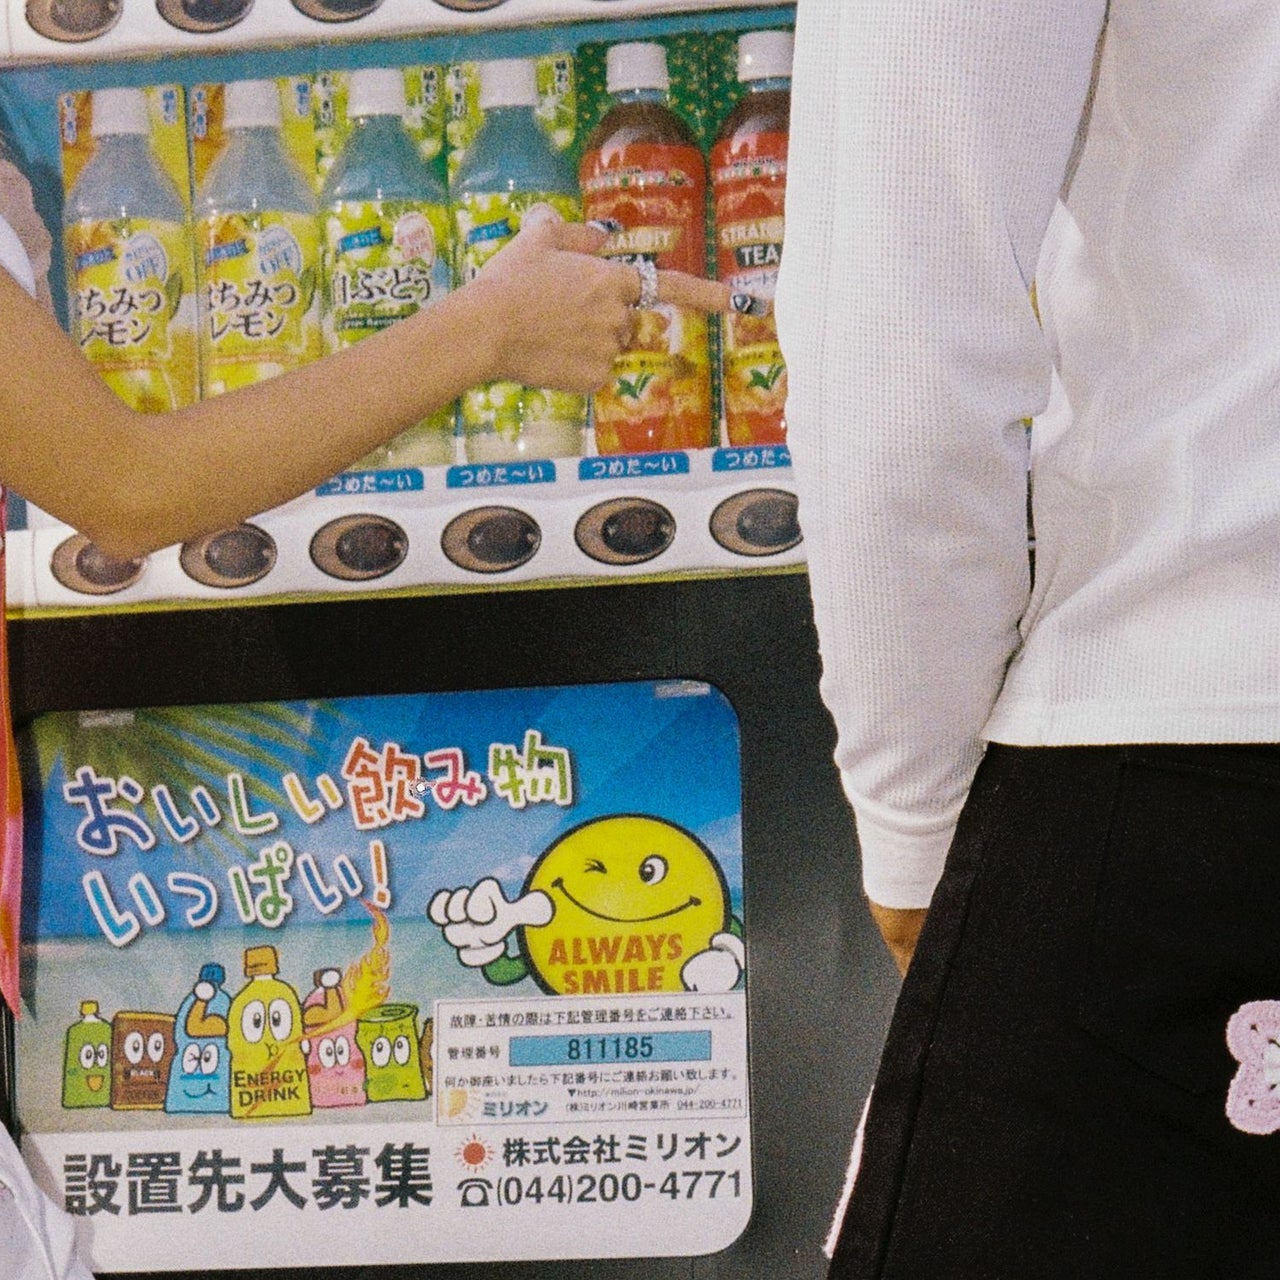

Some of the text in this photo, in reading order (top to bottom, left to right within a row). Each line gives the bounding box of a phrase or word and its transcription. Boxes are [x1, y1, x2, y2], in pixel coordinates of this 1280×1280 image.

[742, 243, 780, 267] TEA
[64, 729, 572, 855] おいしい飲み物
[83, 840, 391, 947] いっぱい!
[548, 933, 683, 966] ALWAYS
[563, 966, 665, 994] SMILE
[447, 1036, 653, 1060] 管理番号 811185
[234, 1069, 305, 1087] ENERGY
[239, 1087, 300, 1107] DRINK
[483, 1100, 548, 1117] ミリオン
[677, 1098, 742, 1110] 044-200-4771
[503, 1132, 742, 1167] 株式会社ミリオン
[64, 1142, 433, 1216] 設置先大募集
[496, 1170, 742, 1206] (044)200-4771
